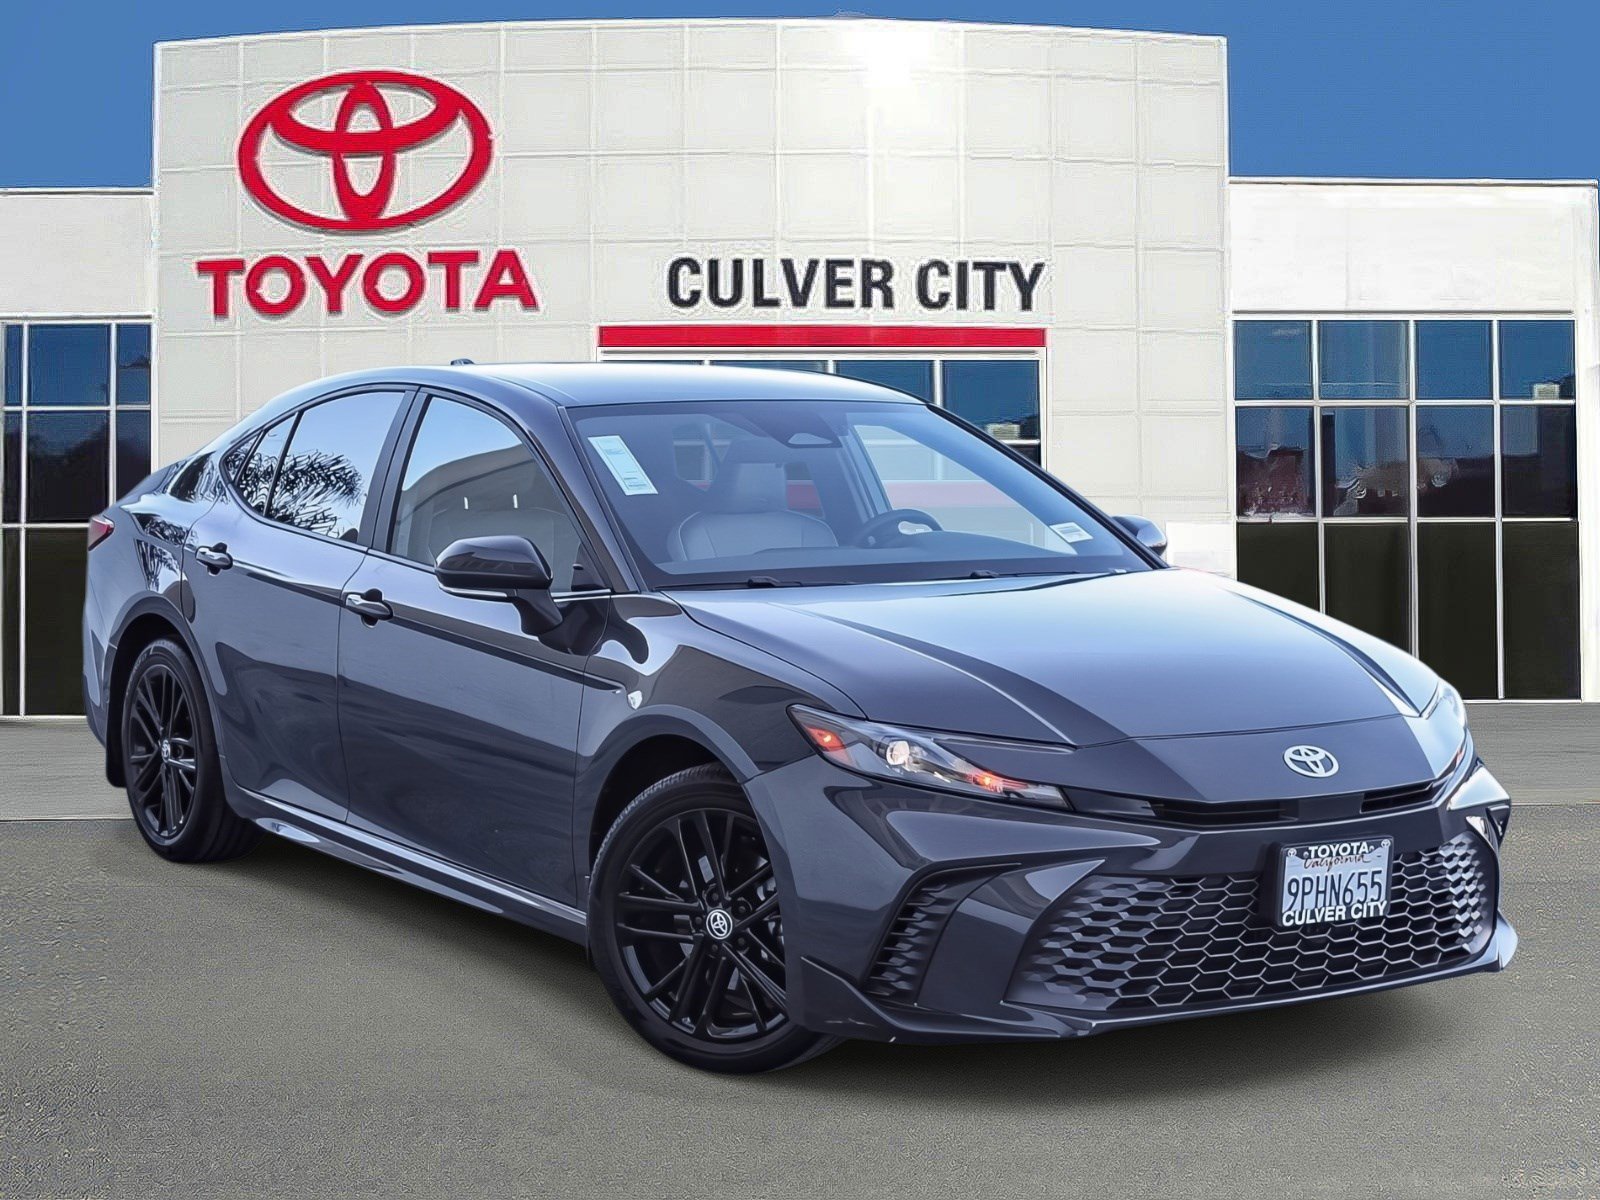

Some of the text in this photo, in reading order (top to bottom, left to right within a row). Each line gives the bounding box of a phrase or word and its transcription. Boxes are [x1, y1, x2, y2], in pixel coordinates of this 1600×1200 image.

[197, 249, 540, 319] TOYOTA
[667, 256, 1046, 311] CULVER CITY
[1308, 841, 1369, 858] TOYOTA
[1287, 869, 1383, 912] 9PHN655
[1282, 900, 1388, 927] CULVER CITY
